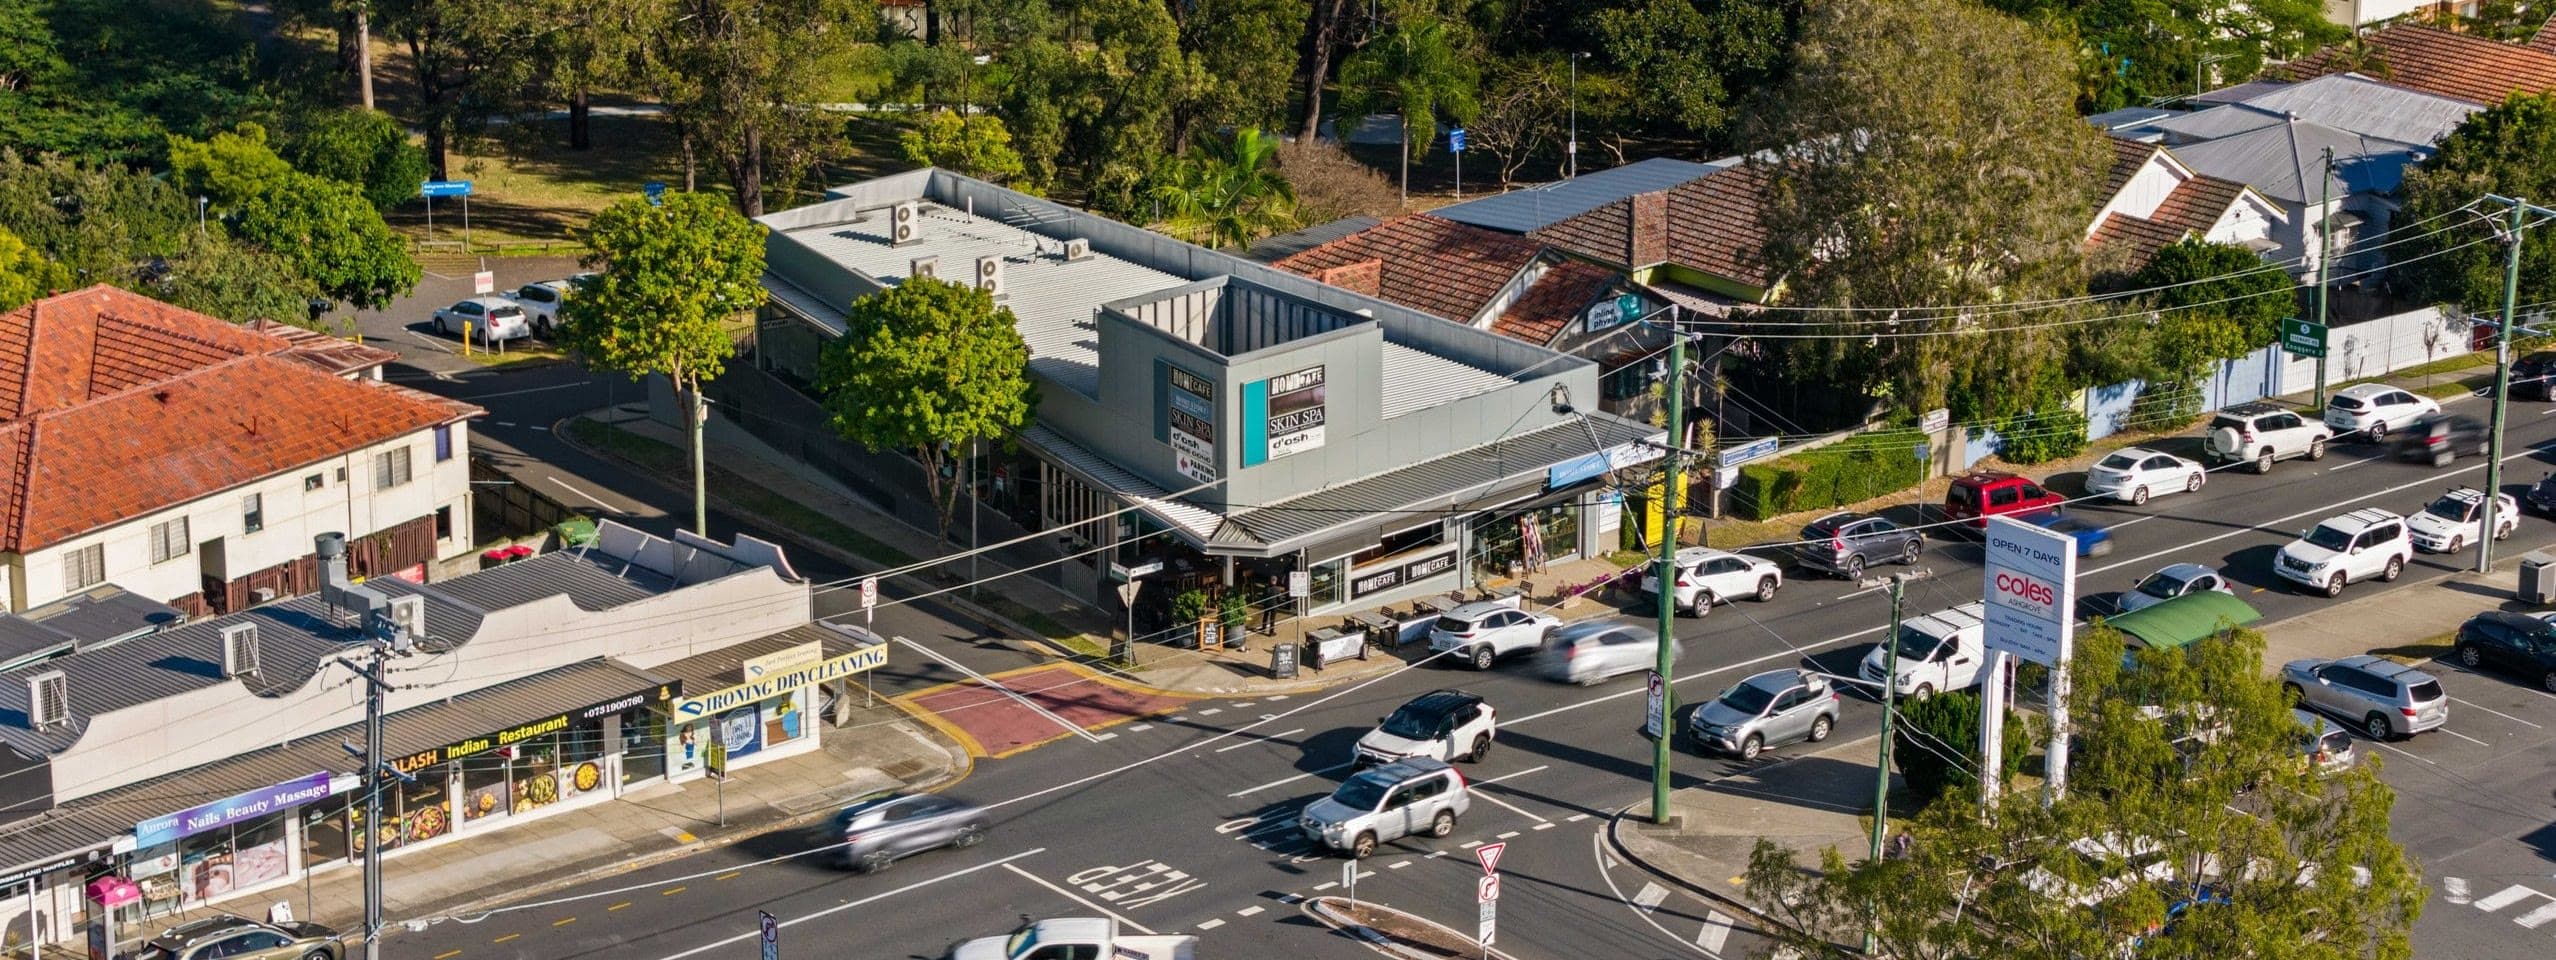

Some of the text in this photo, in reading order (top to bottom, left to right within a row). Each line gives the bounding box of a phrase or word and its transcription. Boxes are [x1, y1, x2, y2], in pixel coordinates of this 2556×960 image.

[1171, 409, 1212, 438] SKIN SPA
[1270, 413, 1299, 431] SKIN
[1302, 408, 1323, 423] SPA
[1273, 433, 1308, 449] d'osh
[1190, 459, 1215, 478] PARKING
[1191, 470, 1198, 479] AT
[1992, 538, 2061, 566] OPEN 7 DAYS
[1996, 573, 2053, 606] coles
[2008, 598, 2041, 614] ASHGROVE
[706, 649, 884, 712] IRONING DRYCLEANING
[447, 737, 489, 759] Indian
[499, 715, 568, 744] Restaurant
[141, 782, 327, 835] Aurora Nails Beauty Massage
[25, 868, 42, 877] AND
[1067, 860, 1208, 910] KEEP
